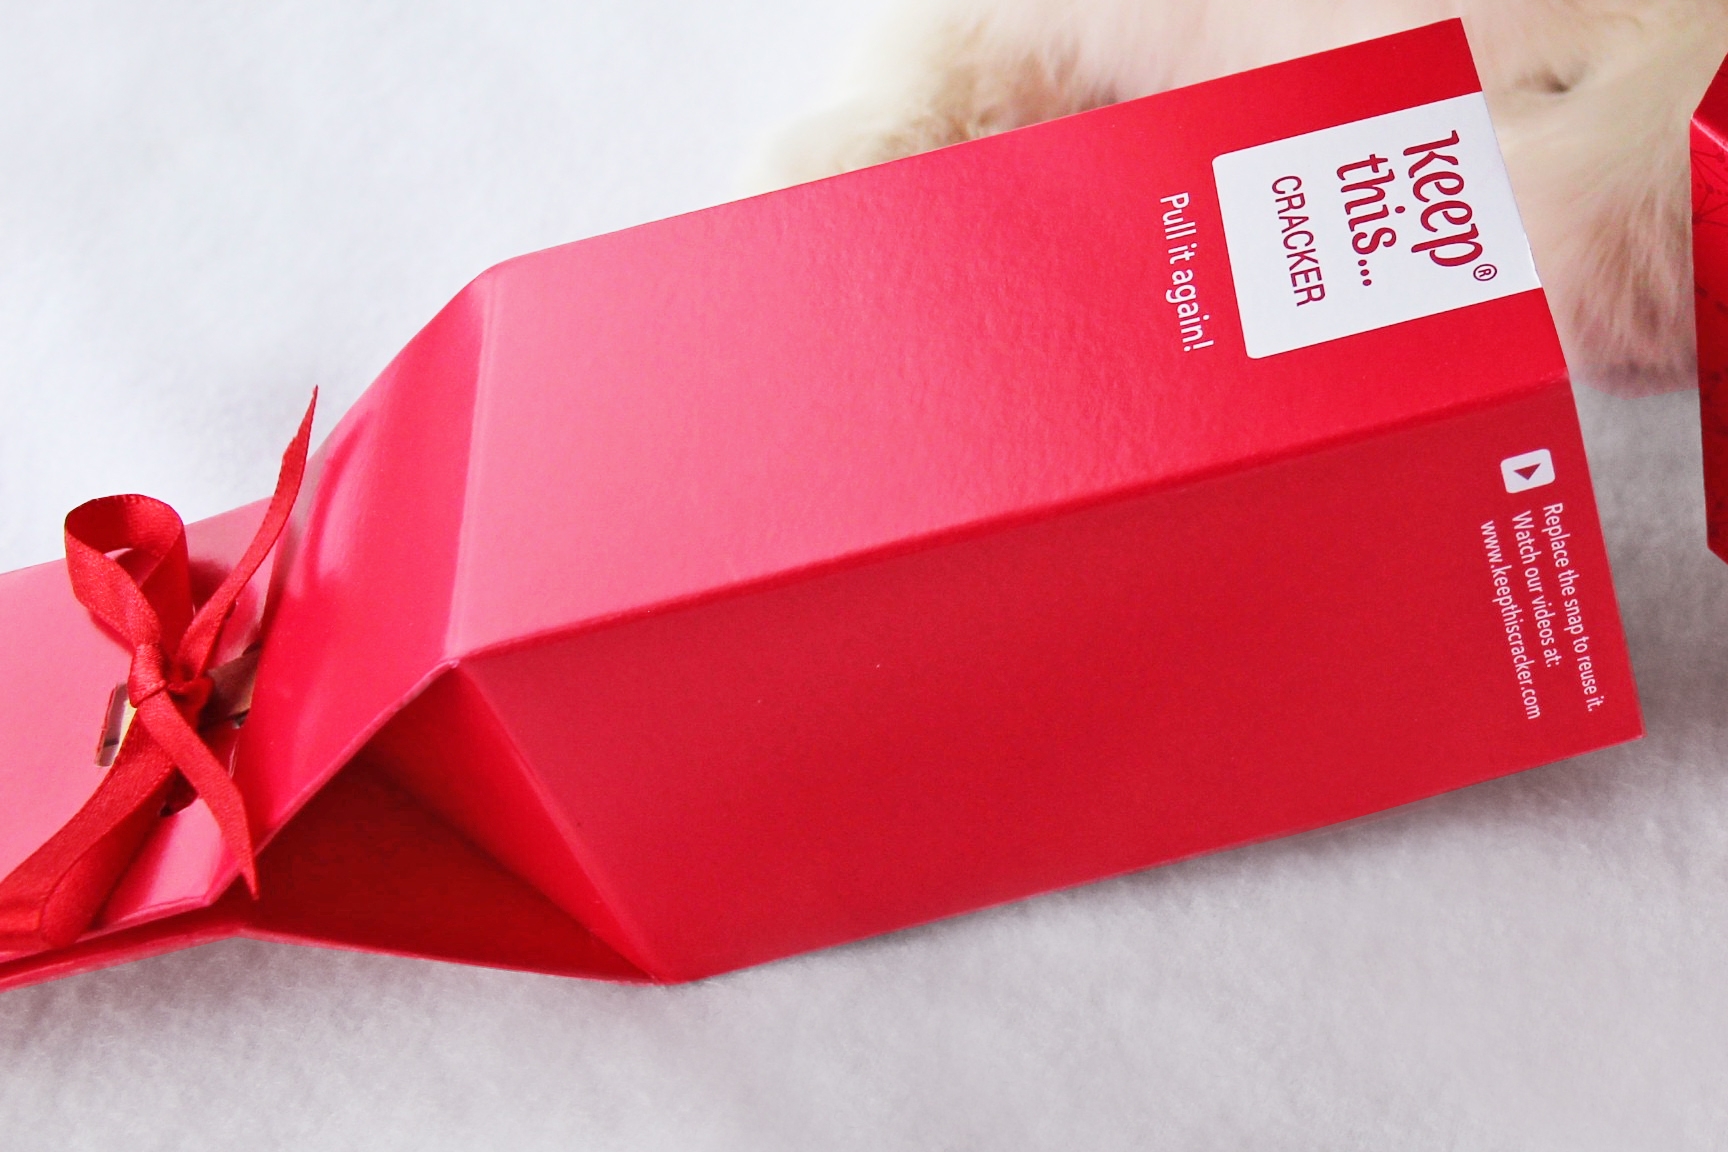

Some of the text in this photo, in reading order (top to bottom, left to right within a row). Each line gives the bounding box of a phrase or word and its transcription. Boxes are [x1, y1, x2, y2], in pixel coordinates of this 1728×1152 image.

[1160, 192, 1214, 352] Pull it again!
[1271, 176, 1325, 307] CRACKER
[1480, 520, 1541, 720] www.keepthiscracker.com
[1512, 510, 1561, 667] Watch our videos at:
[1542, 503, 1604, 712] Replace the snap to reuse it.
